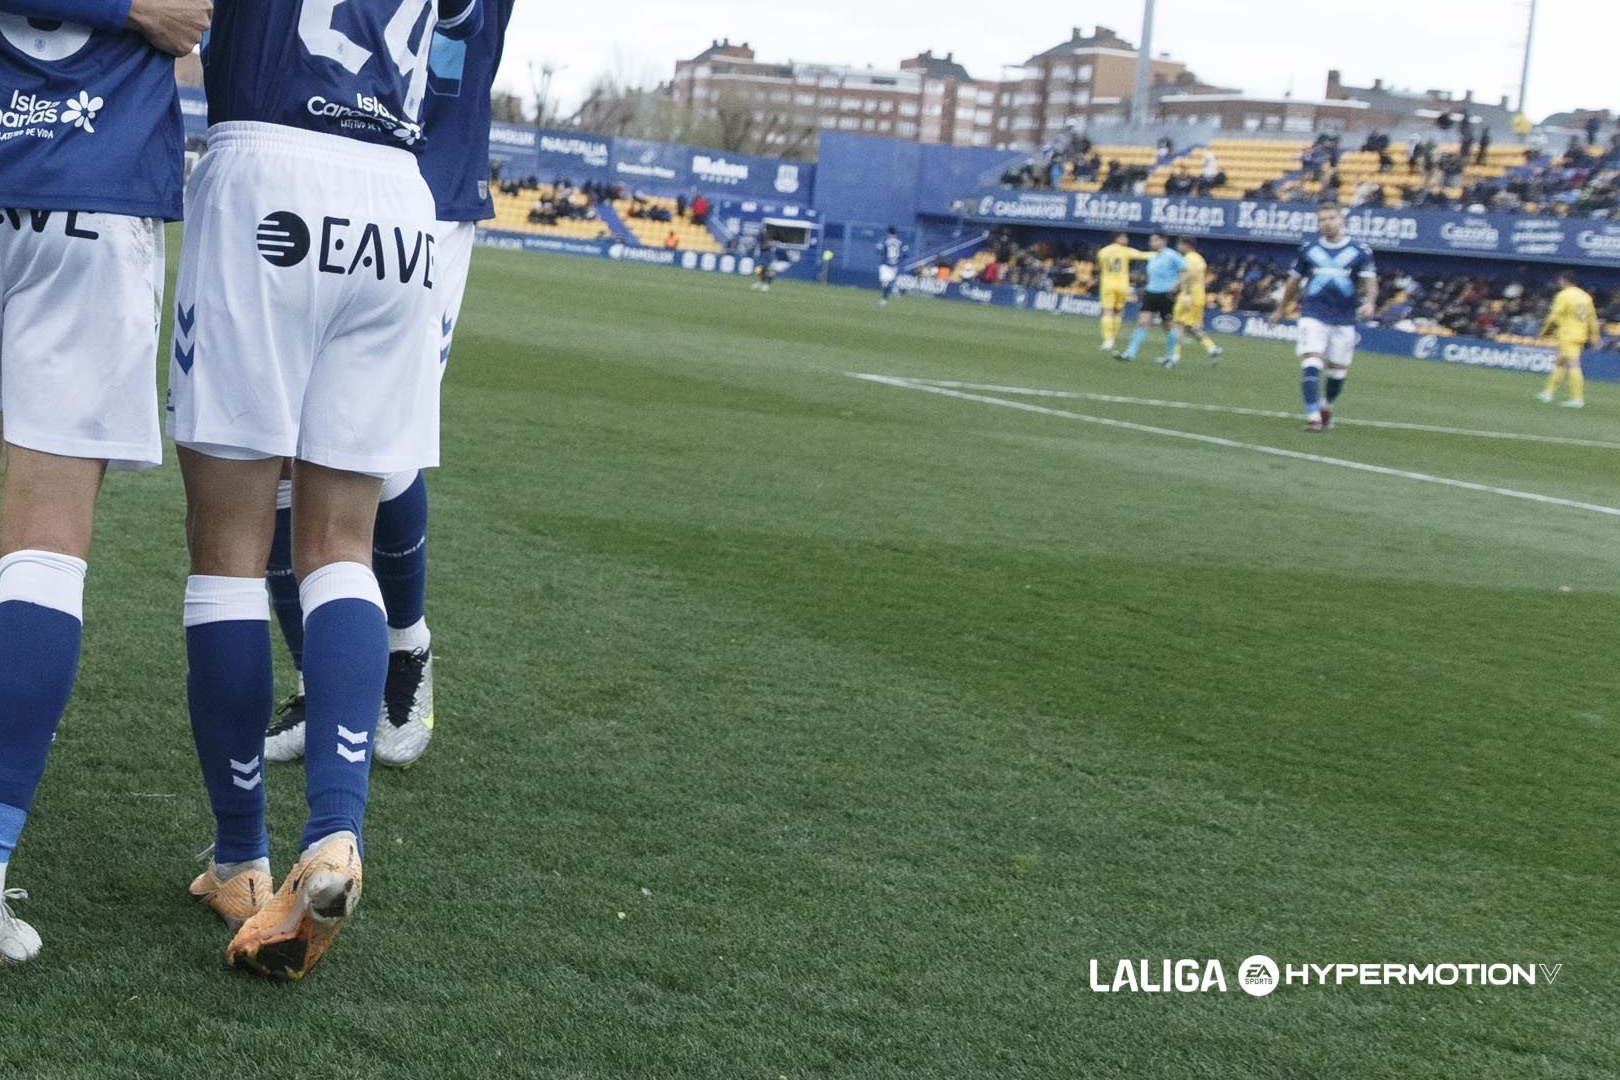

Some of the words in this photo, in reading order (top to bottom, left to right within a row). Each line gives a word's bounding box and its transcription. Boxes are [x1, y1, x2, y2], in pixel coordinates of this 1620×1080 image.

[1074, 193, 1142, 221] Kaizen
[1150, 198, 1224, 227] Kaizen
[1237, 201, 1318, 233] Kaizen
[1340, 207, 1418, 240] aizen
[319, 216, 435, 290] EAVE
